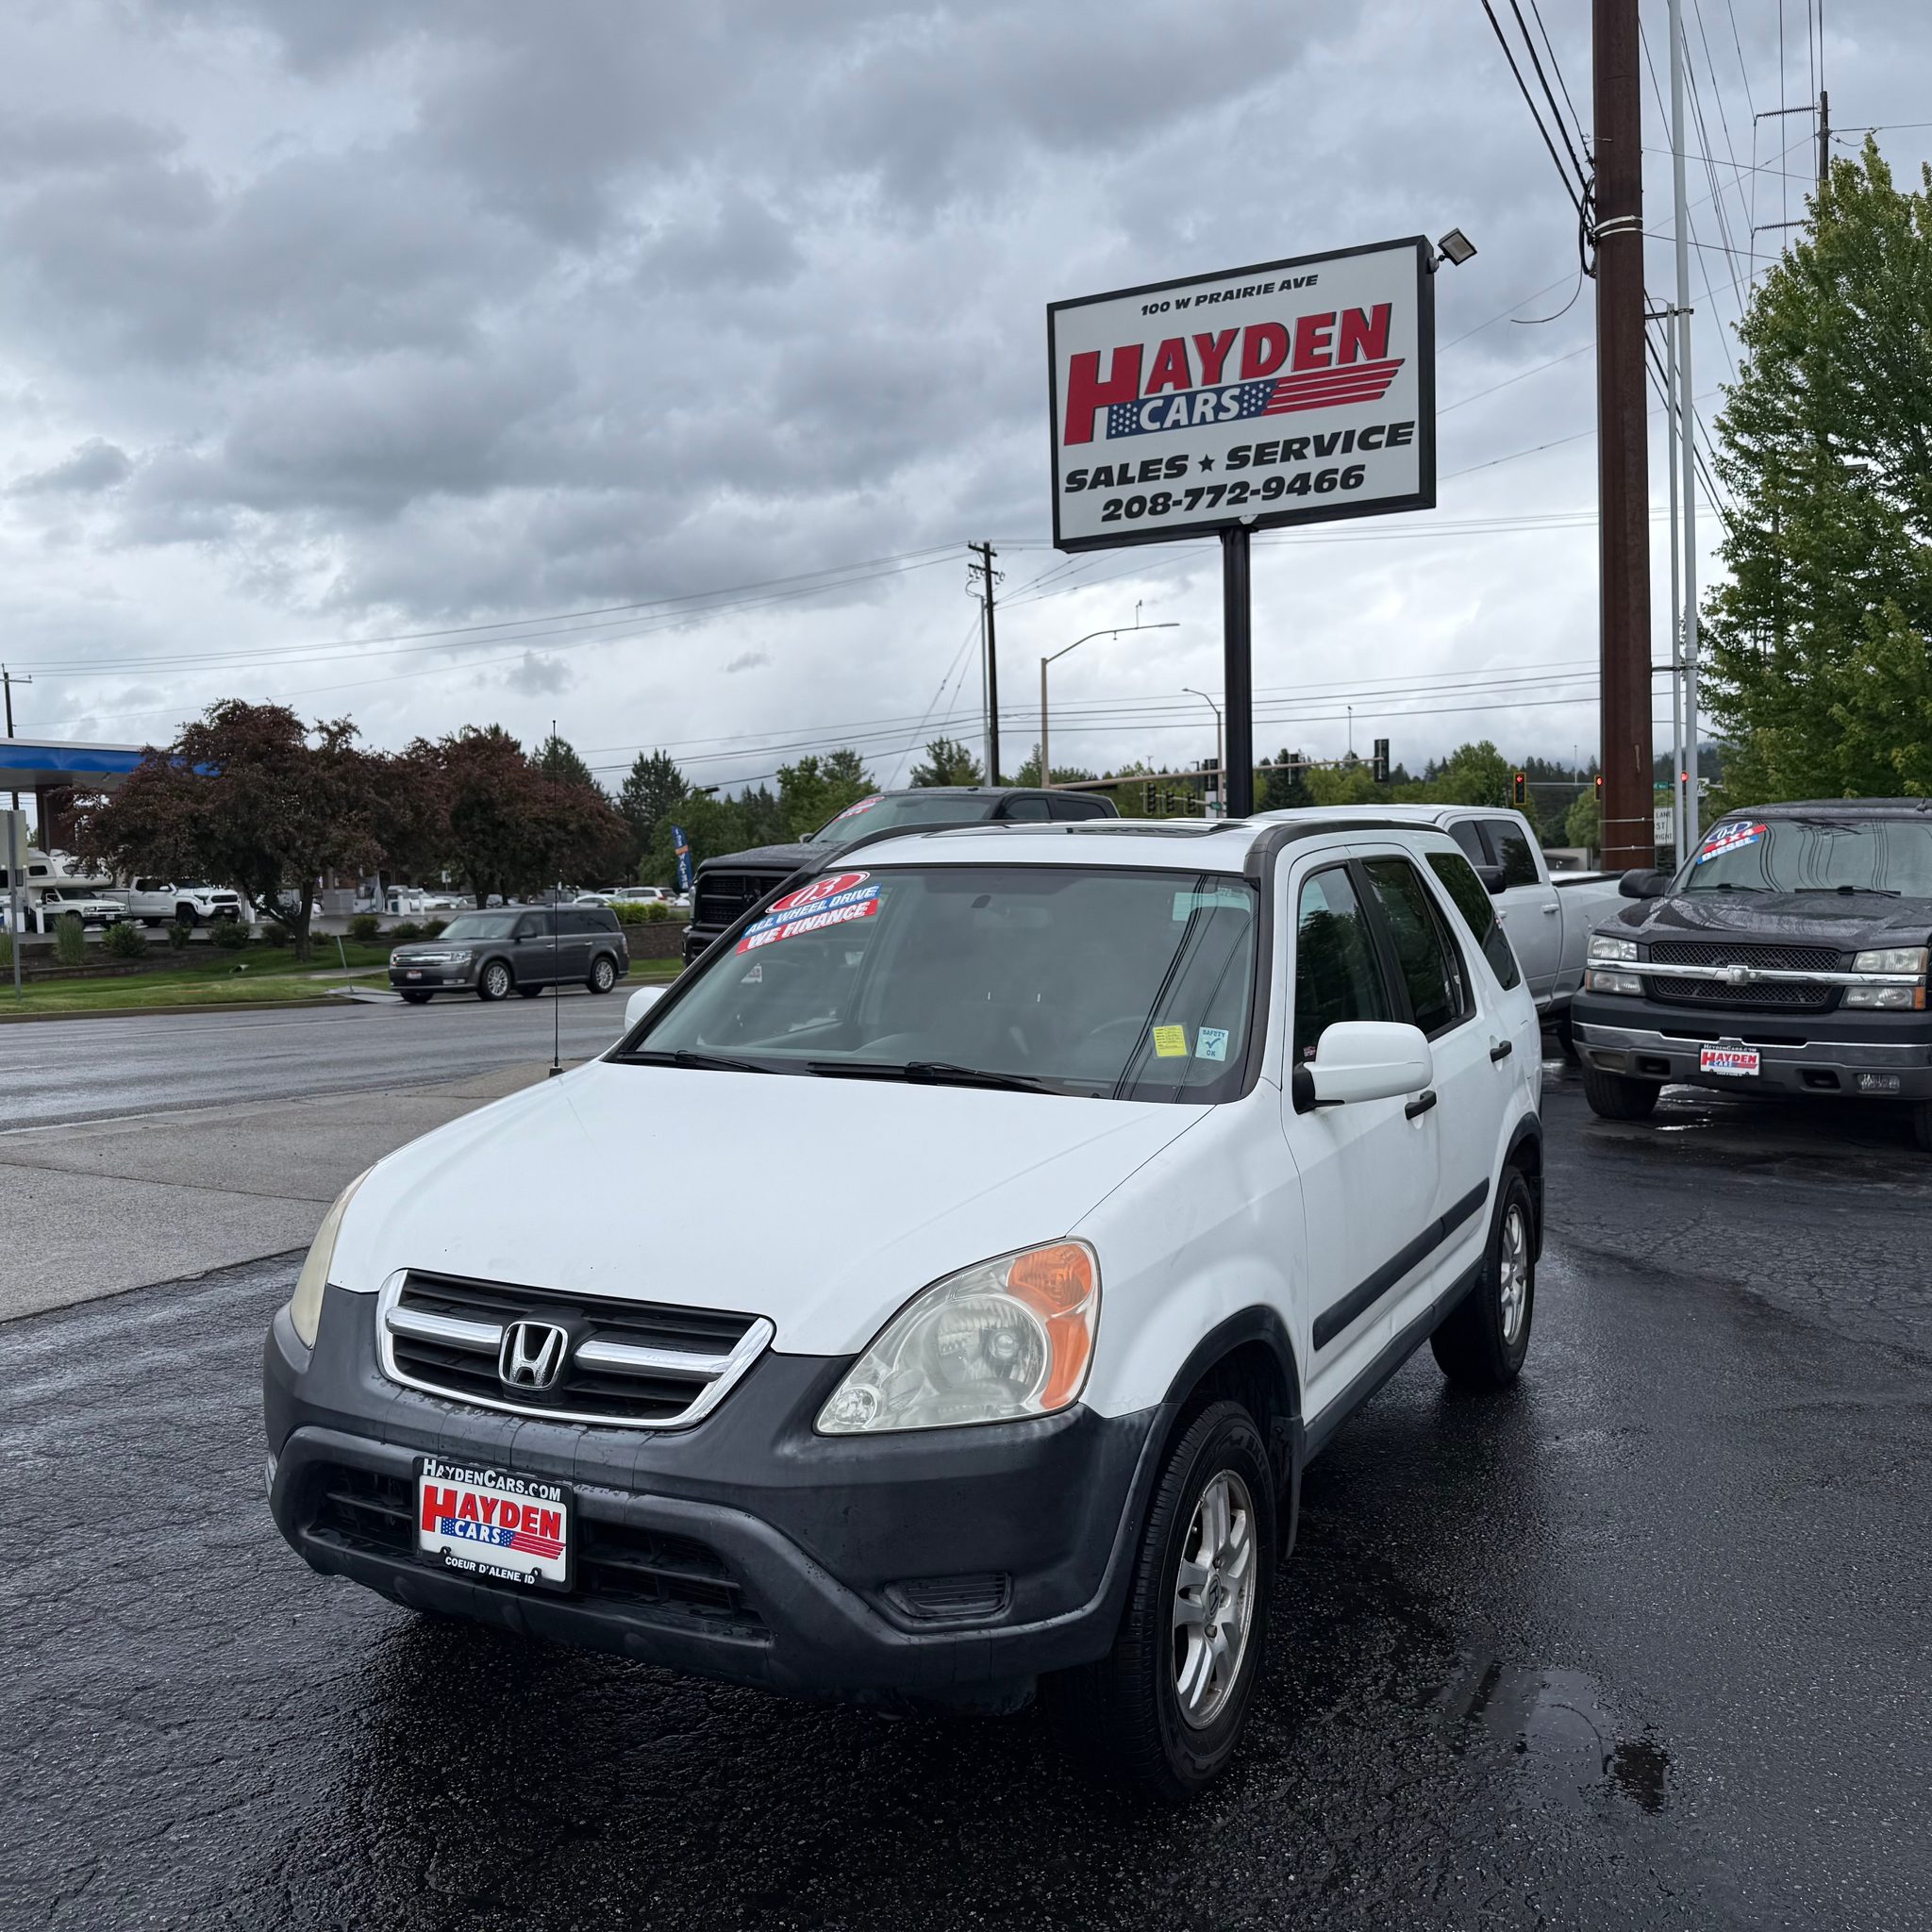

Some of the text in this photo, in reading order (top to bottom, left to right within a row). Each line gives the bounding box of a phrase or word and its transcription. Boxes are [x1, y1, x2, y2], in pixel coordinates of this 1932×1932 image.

[1141, 275, 1319, 317] 100 W PRAIRIE AVE
[1063, 302, 1393, 446] HAYDEN
[1138, 386, 1241, 431] CARS
[1063, 421, 1416, 493] SALES SERVICE
[1101, 464, 1366, 523] 208-772-9466
[744, 885, 880, 937] ALL WHEEL DRIVE
[746, 901, 870, 949] WE FINANCE
[1202, 1029, 1225, 1038] SAFETY
[1702, 1052, 1757, 1065] HAYDEN
[421, 1484, 561, 1541] HAYDEN
[454, 1519, 502, 1544] CARS
[444, 1556, 476, 1572] COEUR
[524, 1574, 536, 1585] ID
